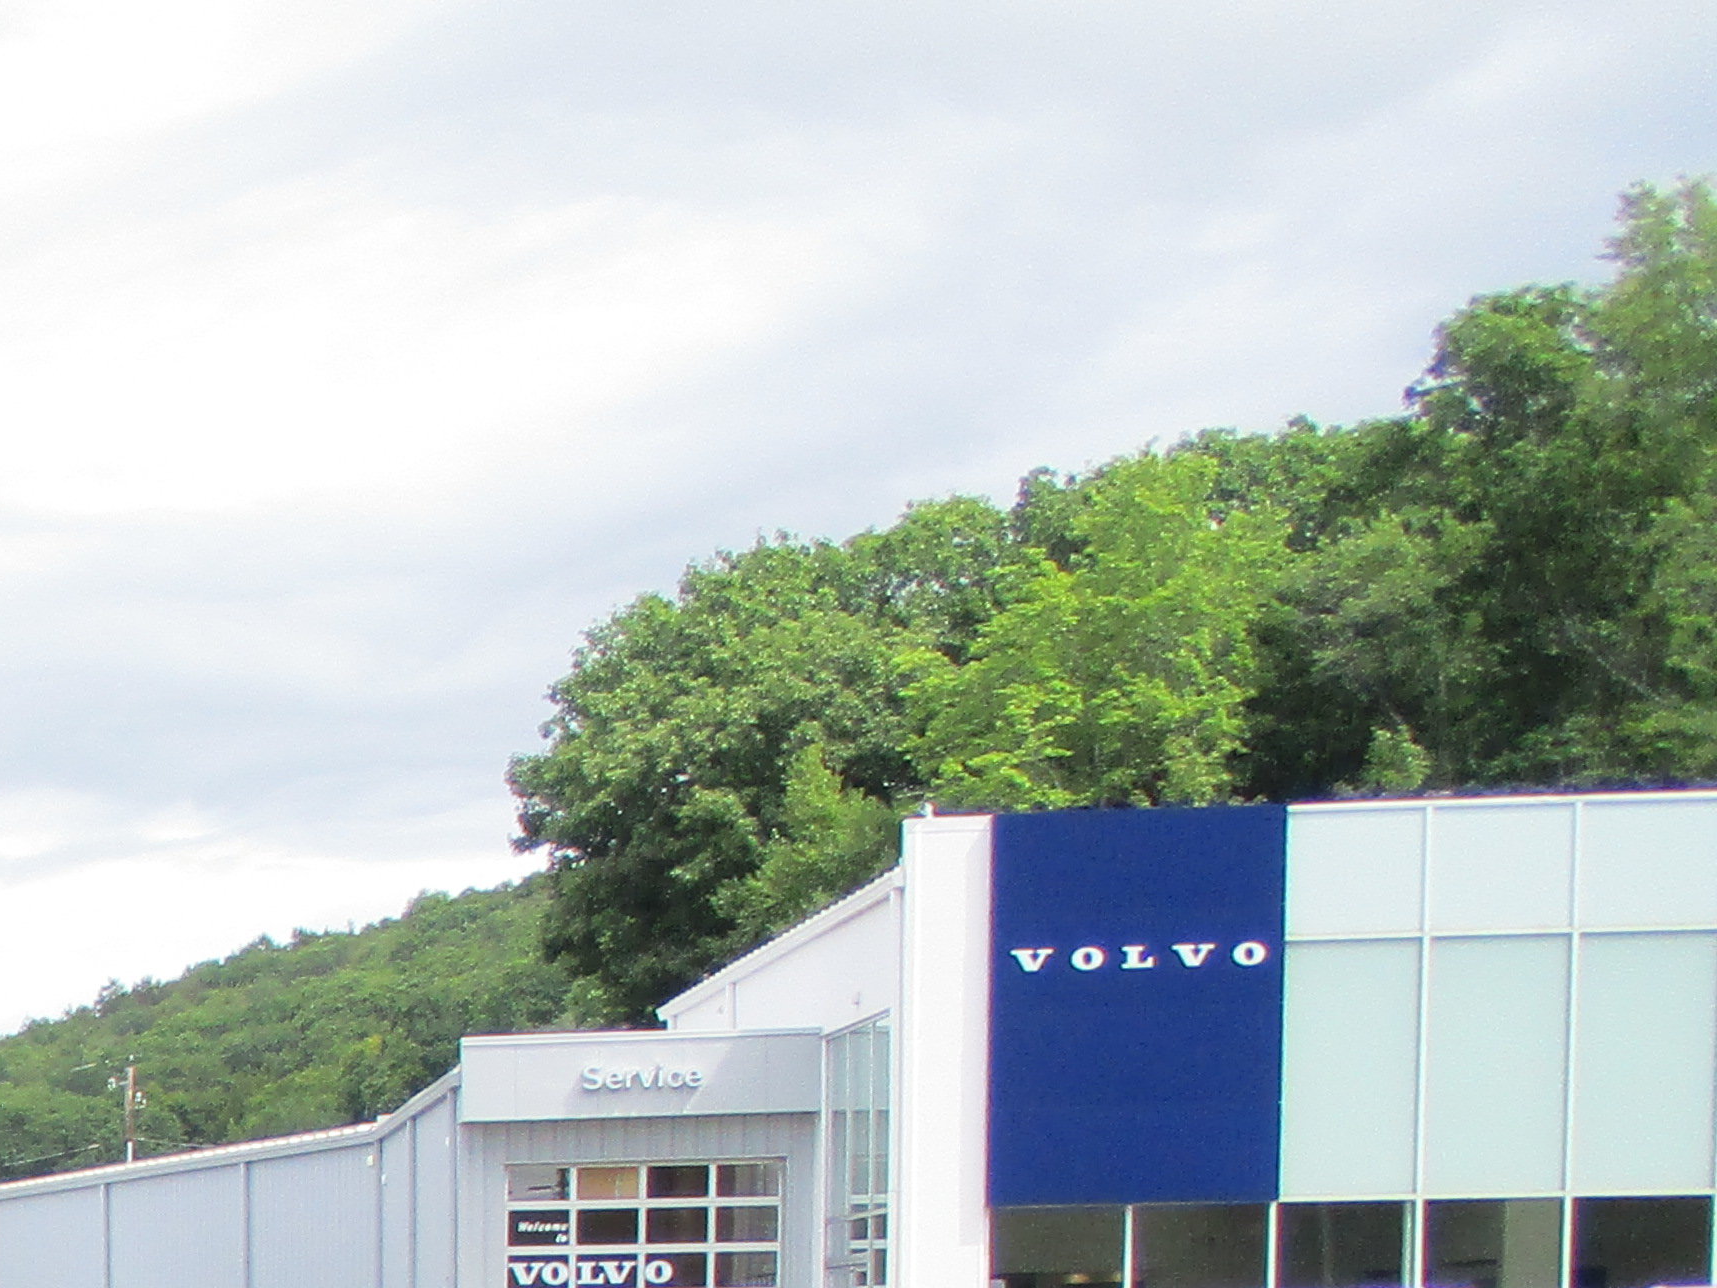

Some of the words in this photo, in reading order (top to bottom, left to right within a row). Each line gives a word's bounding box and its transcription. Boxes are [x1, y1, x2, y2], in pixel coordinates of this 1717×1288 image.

[1009, 941, 1266, 973] VOLVO
[581, 1064, 703, 1091] Service
[508, 1260, 673, 1287] VOLVO
